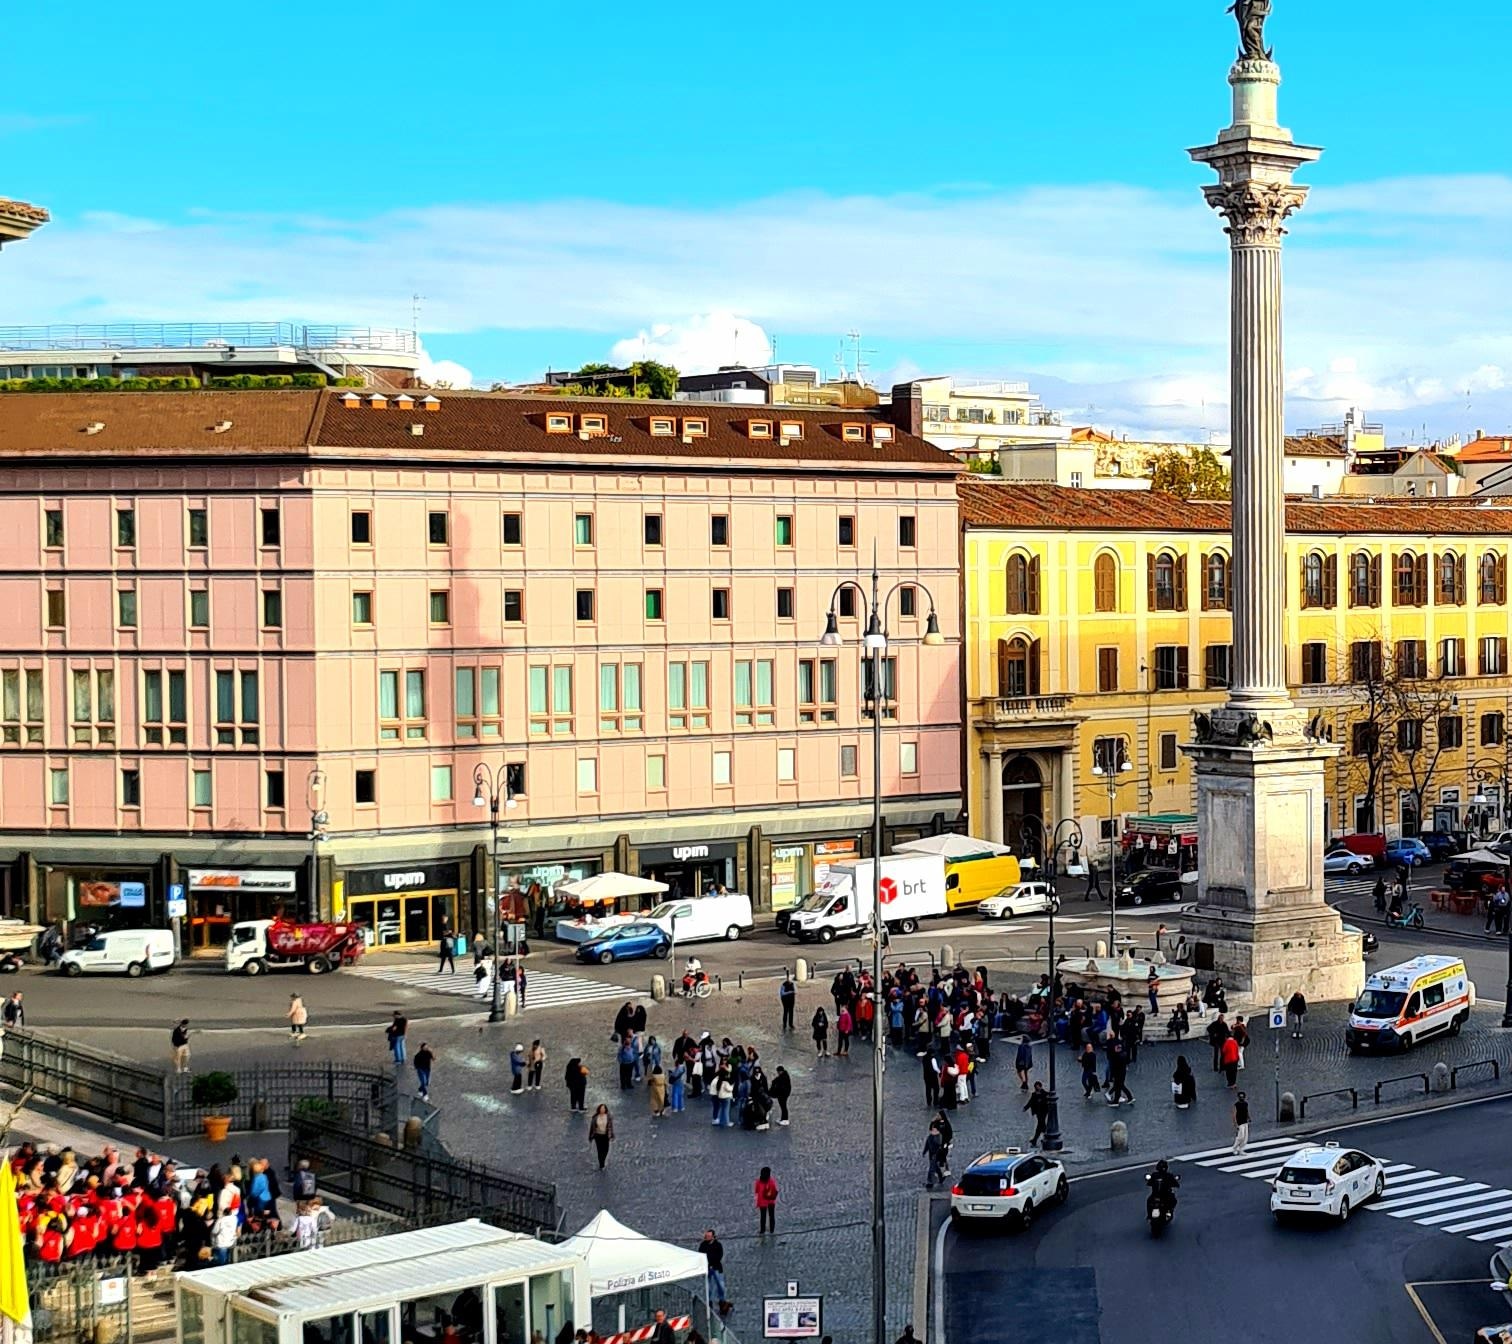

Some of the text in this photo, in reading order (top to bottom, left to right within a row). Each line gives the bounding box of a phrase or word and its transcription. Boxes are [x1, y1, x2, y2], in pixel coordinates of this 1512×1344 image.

[673, 845, 709, 861] upim
[775, 846, 804, 860] upim
[384, 871, 426, 889] upim
[903, 879, 927, 896] brt
[173, 887, 182, 901] P
[607, 1270, 671, 1290] Polizia di Stato
